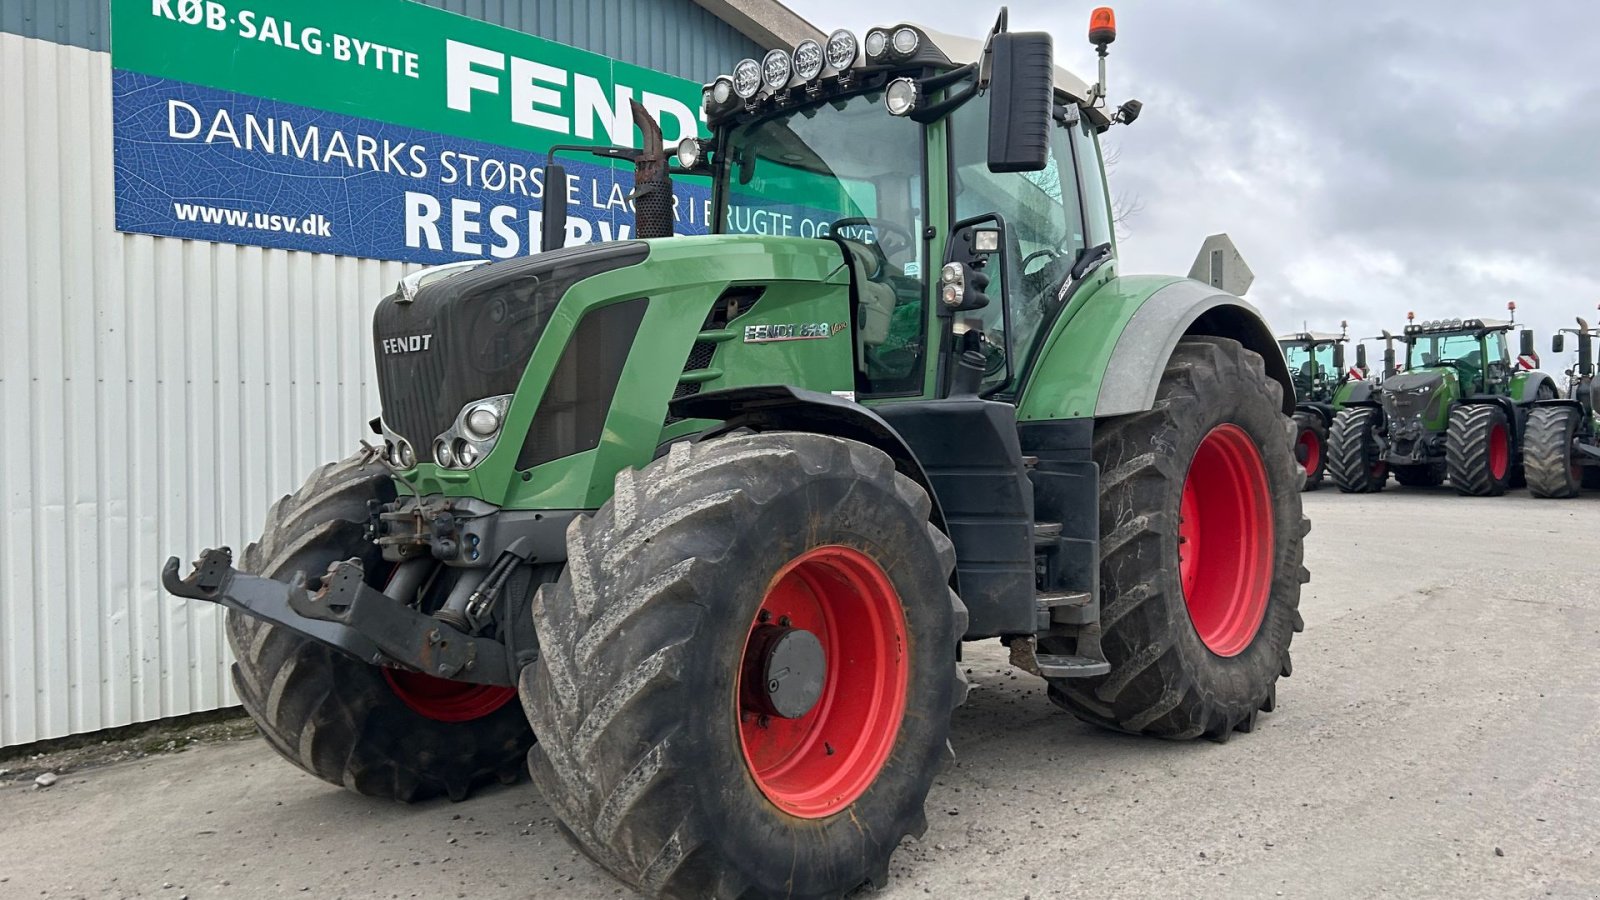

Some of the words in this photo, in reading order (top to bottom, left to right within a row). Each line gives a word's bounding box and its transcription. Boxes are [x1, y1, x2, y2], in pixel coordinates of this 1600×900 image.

[446, 38, 709, 150] FEND
[168, 99, 428, 179] DANMARKS
[440, 150, 581, 205] STØRSE
[592, 178, 680, 222] LAR
[689, 196, 695, 224] I
[173, 203, 332, 237] www.usv.dk
[382, 334, 432, 355] FENDT
[744, 324, 797, 341] FENDT
